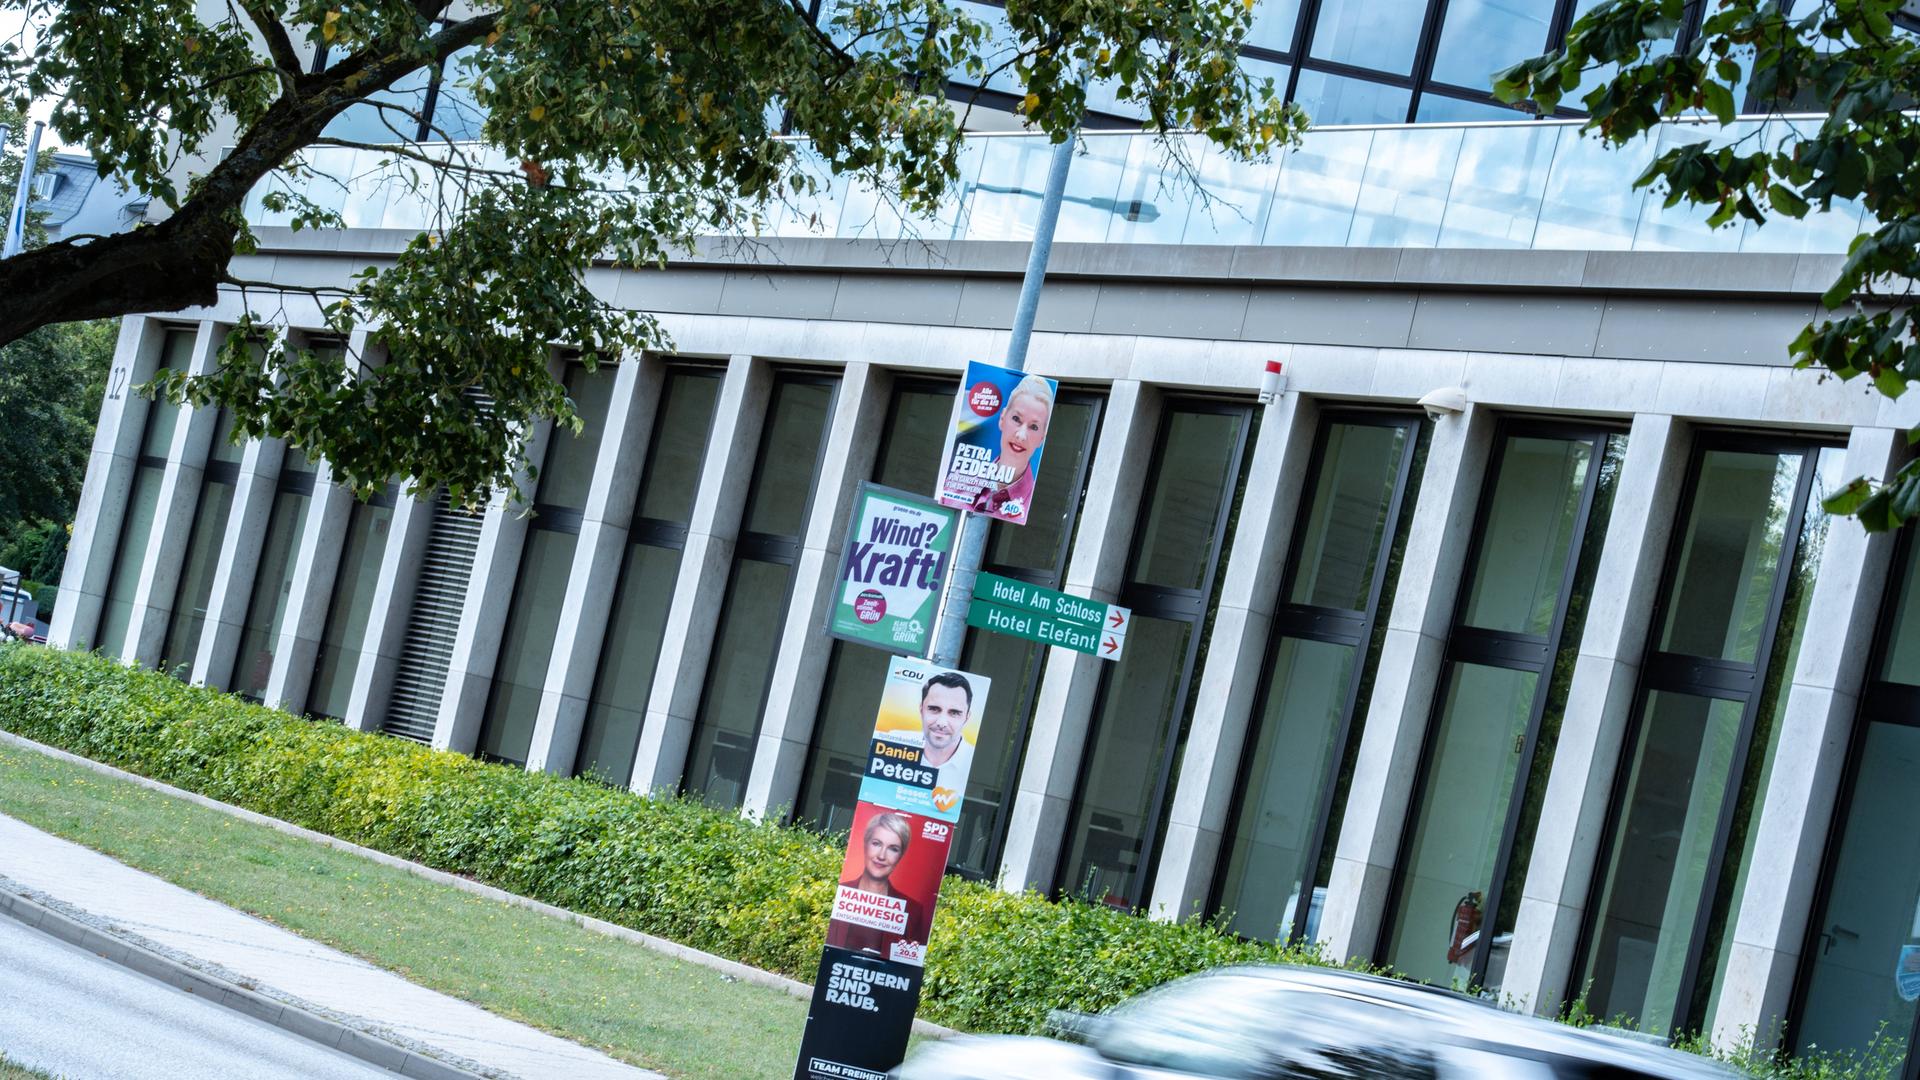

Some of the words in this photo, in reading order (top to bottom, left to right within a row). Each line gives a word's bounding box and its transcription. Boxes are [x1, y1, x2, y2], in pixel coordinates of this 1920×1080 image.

[109, 367, 126, 399] 12
[989, 399, 1000, 407] AfD
[956, 443, 992, 461] PETRA
[951, 456, 1016, 483] FEDERAU
[1005, 504, 1019, 513] AfD
[870, 517, 938, 549] Wind?
[844, 542, 946, 591] Kraft!
[993, 581, 1025, 604] Hotel
[1030, 591, 1050, 610] Am
[1056, 597, 1102, 623] Schloss
[860, 610, 881, 621] GRÜN
[988, 609, 1031, 634] Hotel
[1038, 621, 1096, 649] Elefant
[902, 669, 924, 680] CDU
[875, 742, 919, 762] Daniel
[871, 758, 933, 785] Peters
[924, 821, 948, 836] SPD
[841, 889, 902, 911] MANUELA
[836, 912, 877, 926] ENTSCHEIDUNG
[878, 922, 890, 930] FÜR
[838, 901, 904, 924] SCHWESIG
[899, 949, 918, 959] 20.9.
[828, 976, 871, 995] SIND
[831, 963, 910, 991] STEUERN
[825, 989, 879, 1012] RAUB.
[813, 1061, 841, 1074] TEAM
[842, 1066, 885, 1080] FREIHEIT
